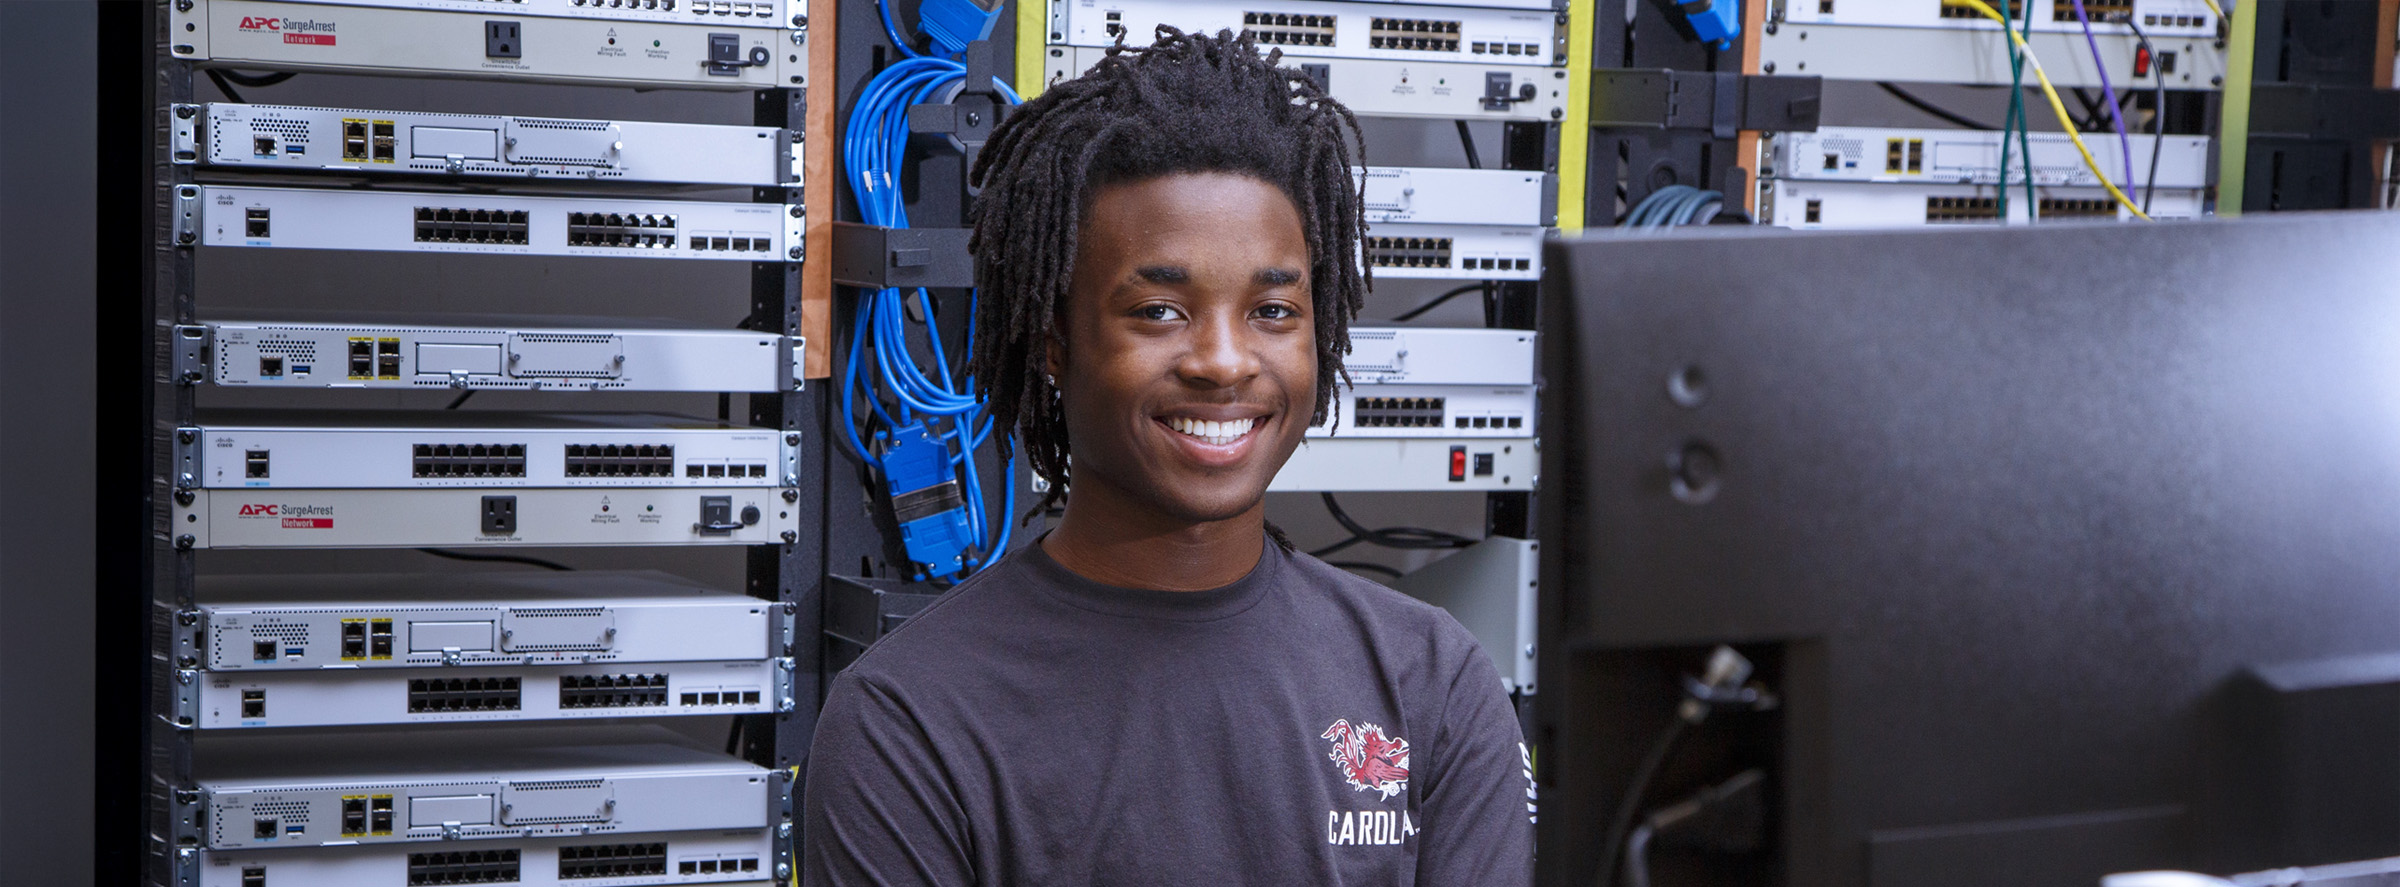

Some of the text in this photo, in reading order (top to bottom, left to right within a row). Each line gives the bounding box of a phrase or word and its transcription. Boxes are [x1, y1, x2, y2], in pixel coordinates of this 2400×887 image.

[239, 16, 336, 33] APC SurgeArrest
[285, 34, 316, 44] Network
[238, 504, 333, 518] APC SurgeArrest
[283, 518, 314, 528] Network
